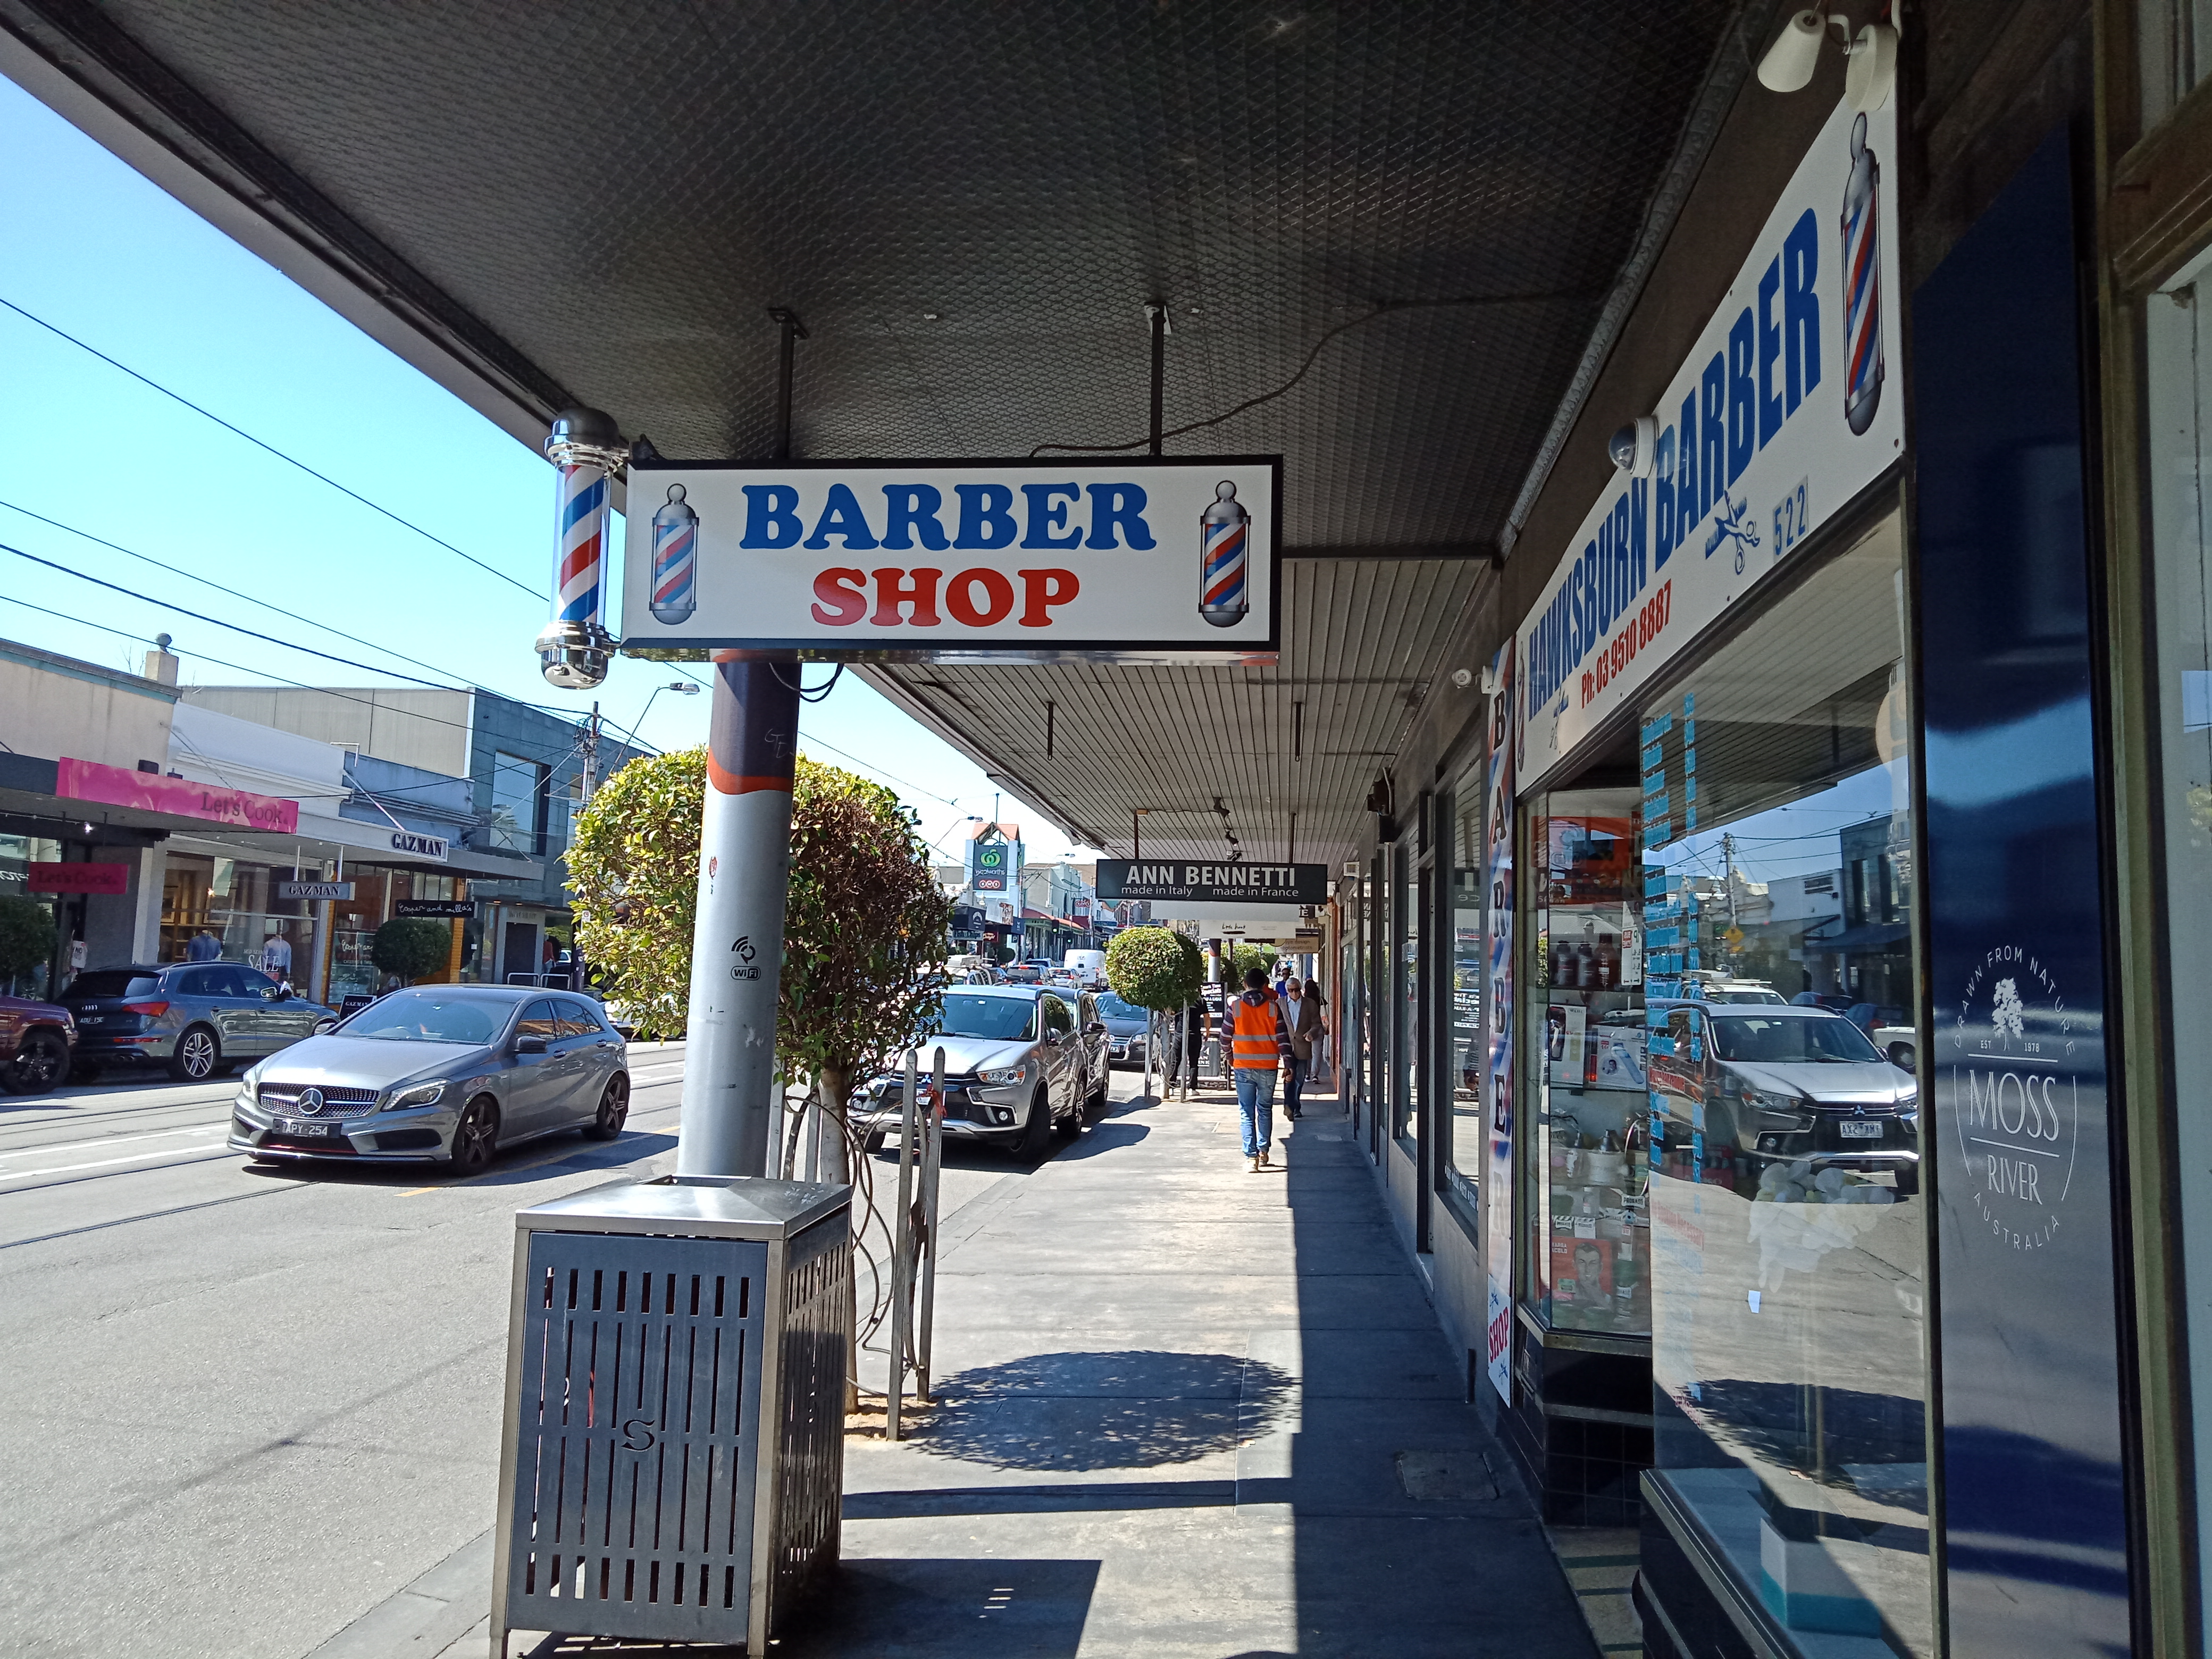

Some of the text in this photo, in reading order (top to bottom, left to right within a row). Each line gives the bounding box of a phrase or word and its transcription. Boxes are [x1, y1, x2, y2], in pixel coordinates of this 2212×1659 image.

[1529, 208, 1821, 723] HAWKSBURN BARBER
[740, 483, 1157, 551] BARBER
[1773, 483, 1806, 555] 522
[812, 567, 1080, 628] SHOP
[1581, 580, 1672, 709] Ph: 03 9510 8887
[201, 792, 240, 816] Let's
[392, 833, 443, 857] GAZMAN
[289, 885, 340, 896] GAZMAN
[1121, 886, 1299, 898] made in Italy made in France
[1126, 865, 1295, 887] ANN BENNETTI
[248, 954, 279, 972] SALE
[1954, 945, 2075, 1056] DRAWN FROM NATURE
[2024, 1042, 2040, 1053] 1978
[1969, 1069, 2059, 1142] MOSS
[1987, 1154, 2042, 1205] RIVER
[1973, 1192, 2059, 1251] AUSTRALIA
[1489, 1306, 1509, 1363] SHOP
